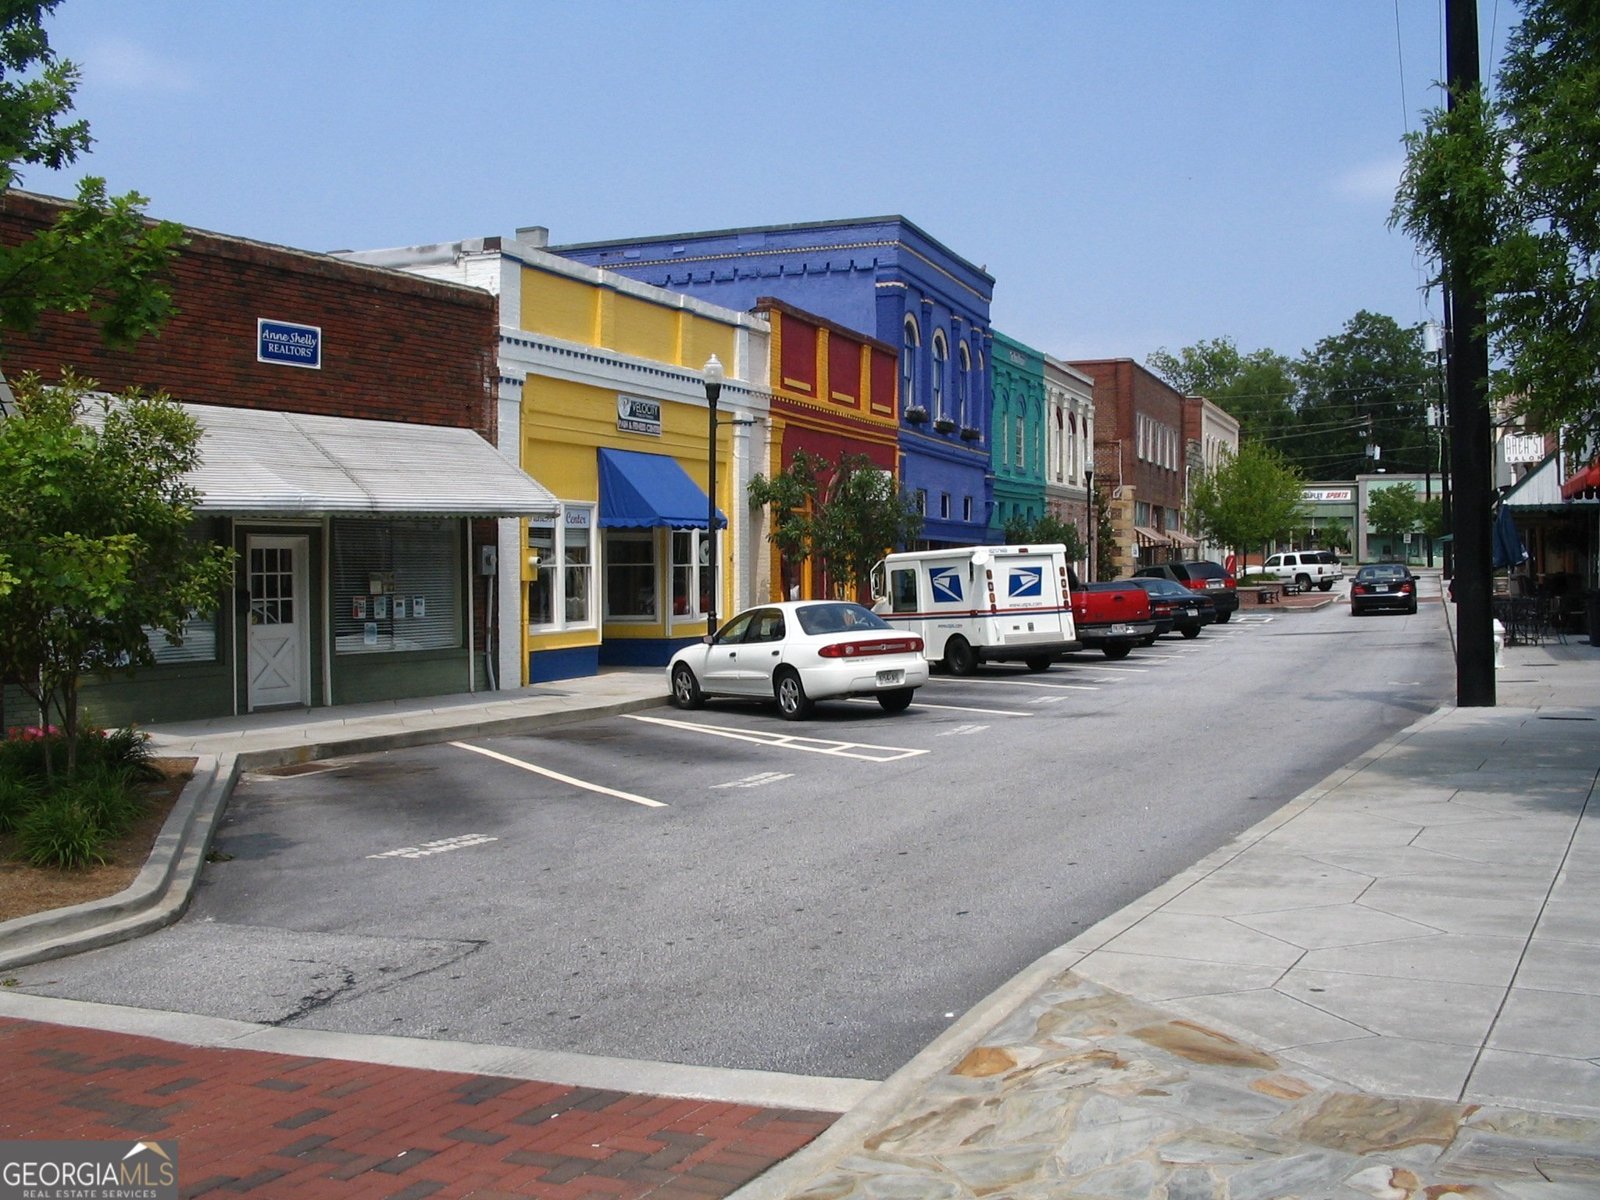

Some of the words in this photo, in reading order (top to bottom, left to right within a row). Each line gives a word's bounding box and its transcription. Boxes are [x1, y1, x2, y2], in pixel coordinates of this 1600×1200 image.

[262, 329, 289, 342] Anne
[289, 332, 317, 348] Shelly
[268, 343, 313, 358] REALTORS
[632, 402, 658, 416] VELOCITY
[1326, 491, 1348, 499] SPORTS
[566, 511, 587, 524] Center
